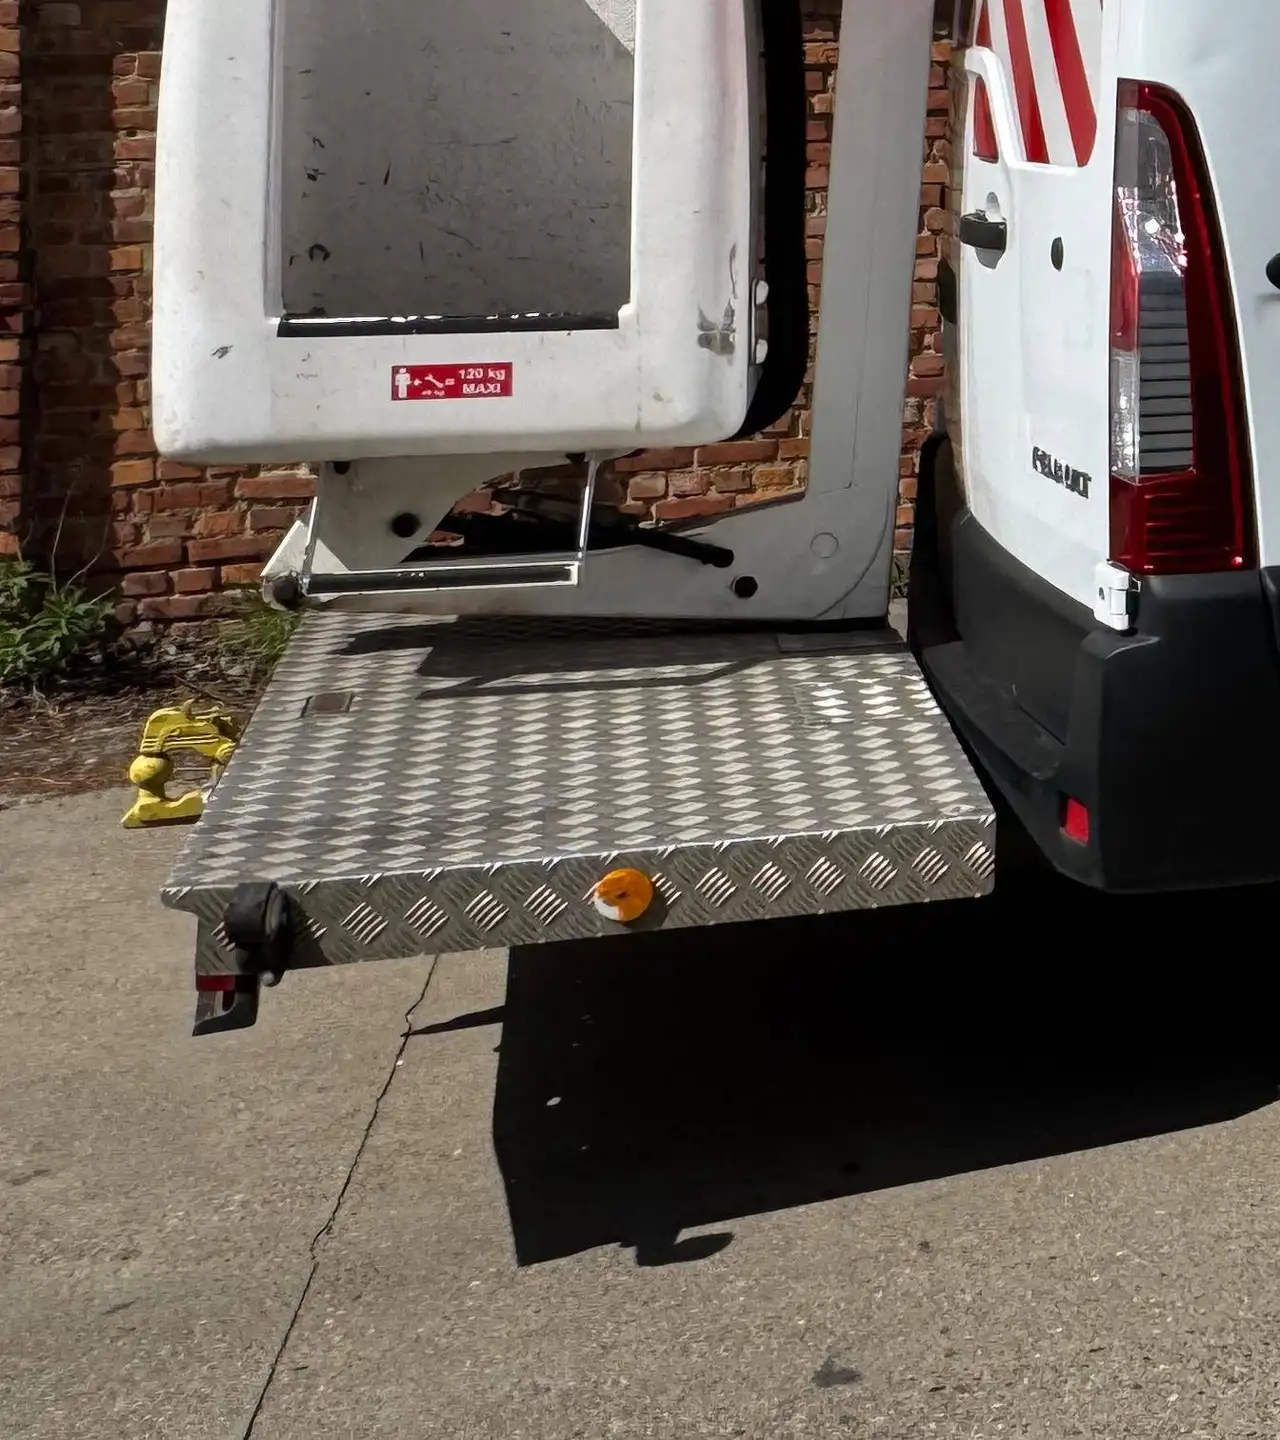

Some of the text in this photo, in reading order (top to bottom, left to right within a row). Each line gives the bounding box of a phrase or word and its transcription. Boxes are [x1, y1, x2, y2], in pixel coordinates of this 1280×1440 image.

[458, 367, 506, 381] 120 kg
[462, 382, 502, 395] MAXI
